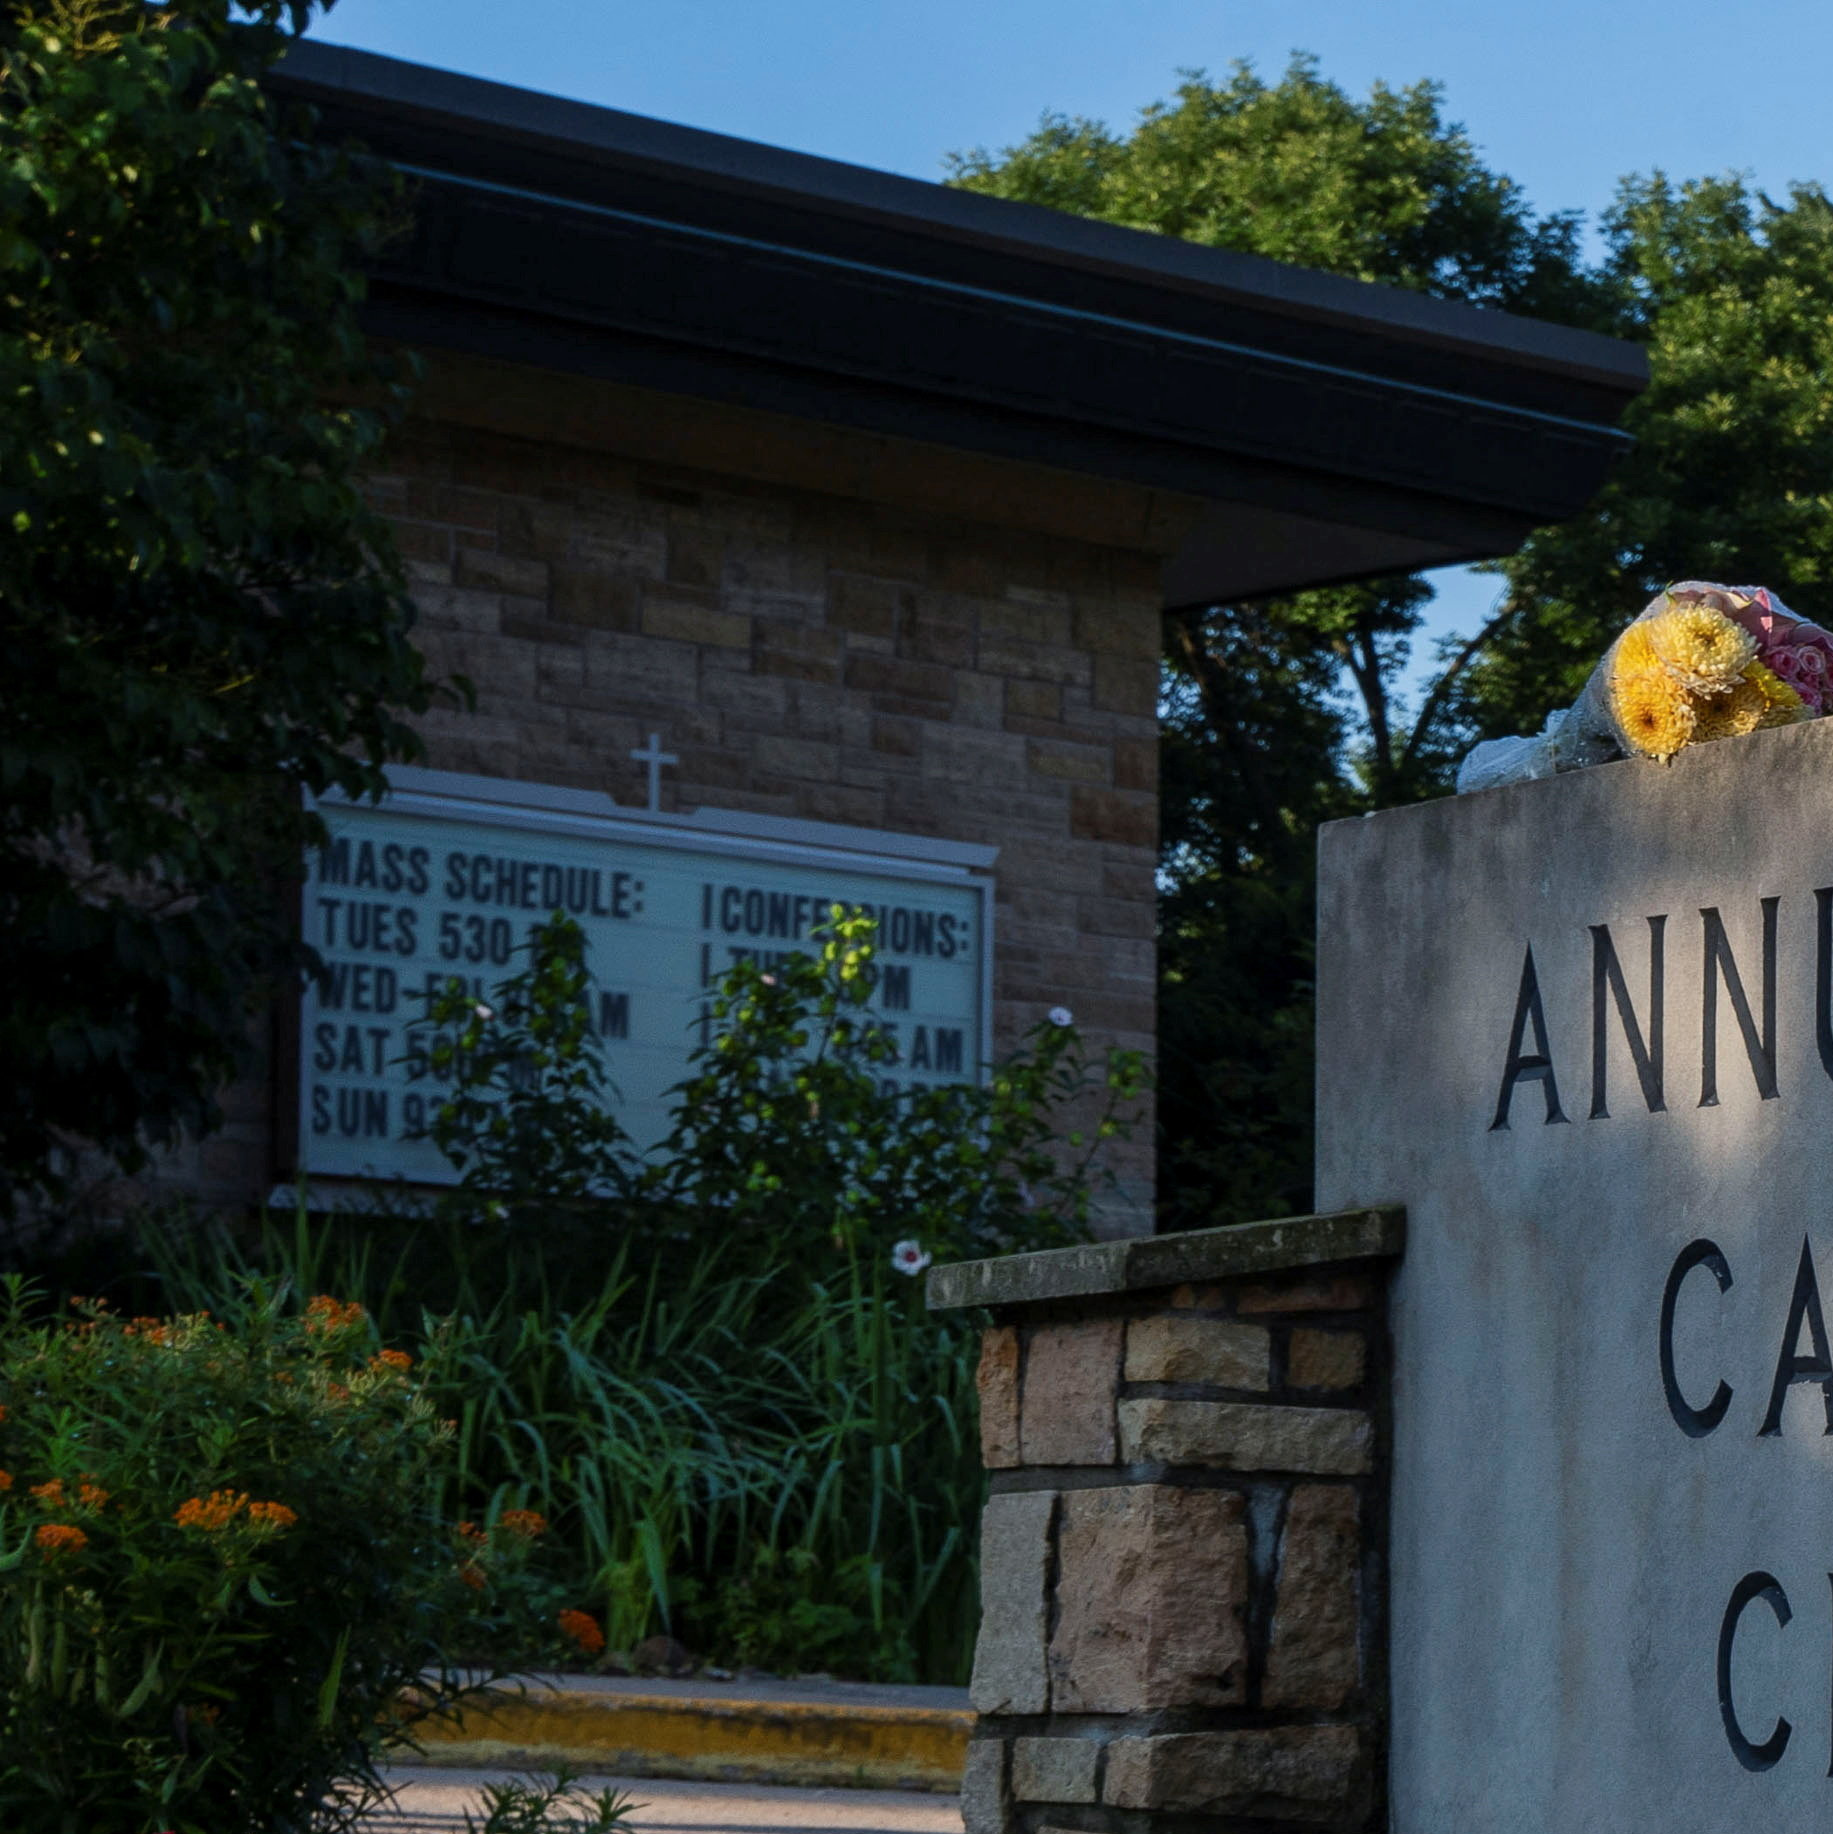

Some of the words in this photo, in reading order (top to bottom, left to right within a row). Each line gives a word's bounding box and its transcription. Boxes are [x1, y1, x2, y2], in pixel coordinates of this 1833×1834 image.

[319, 837, 430, 896] MASS
[444, 851, 645, 919] SCHEDULE:
[317, 897, 418, 957] TUES
[438, 912, 512, 966] 530
[313, 1022, 391, 1076] SAT
[910, 1024, 964, 1073] AM
[311, 1084, 389, 1138] SUN
